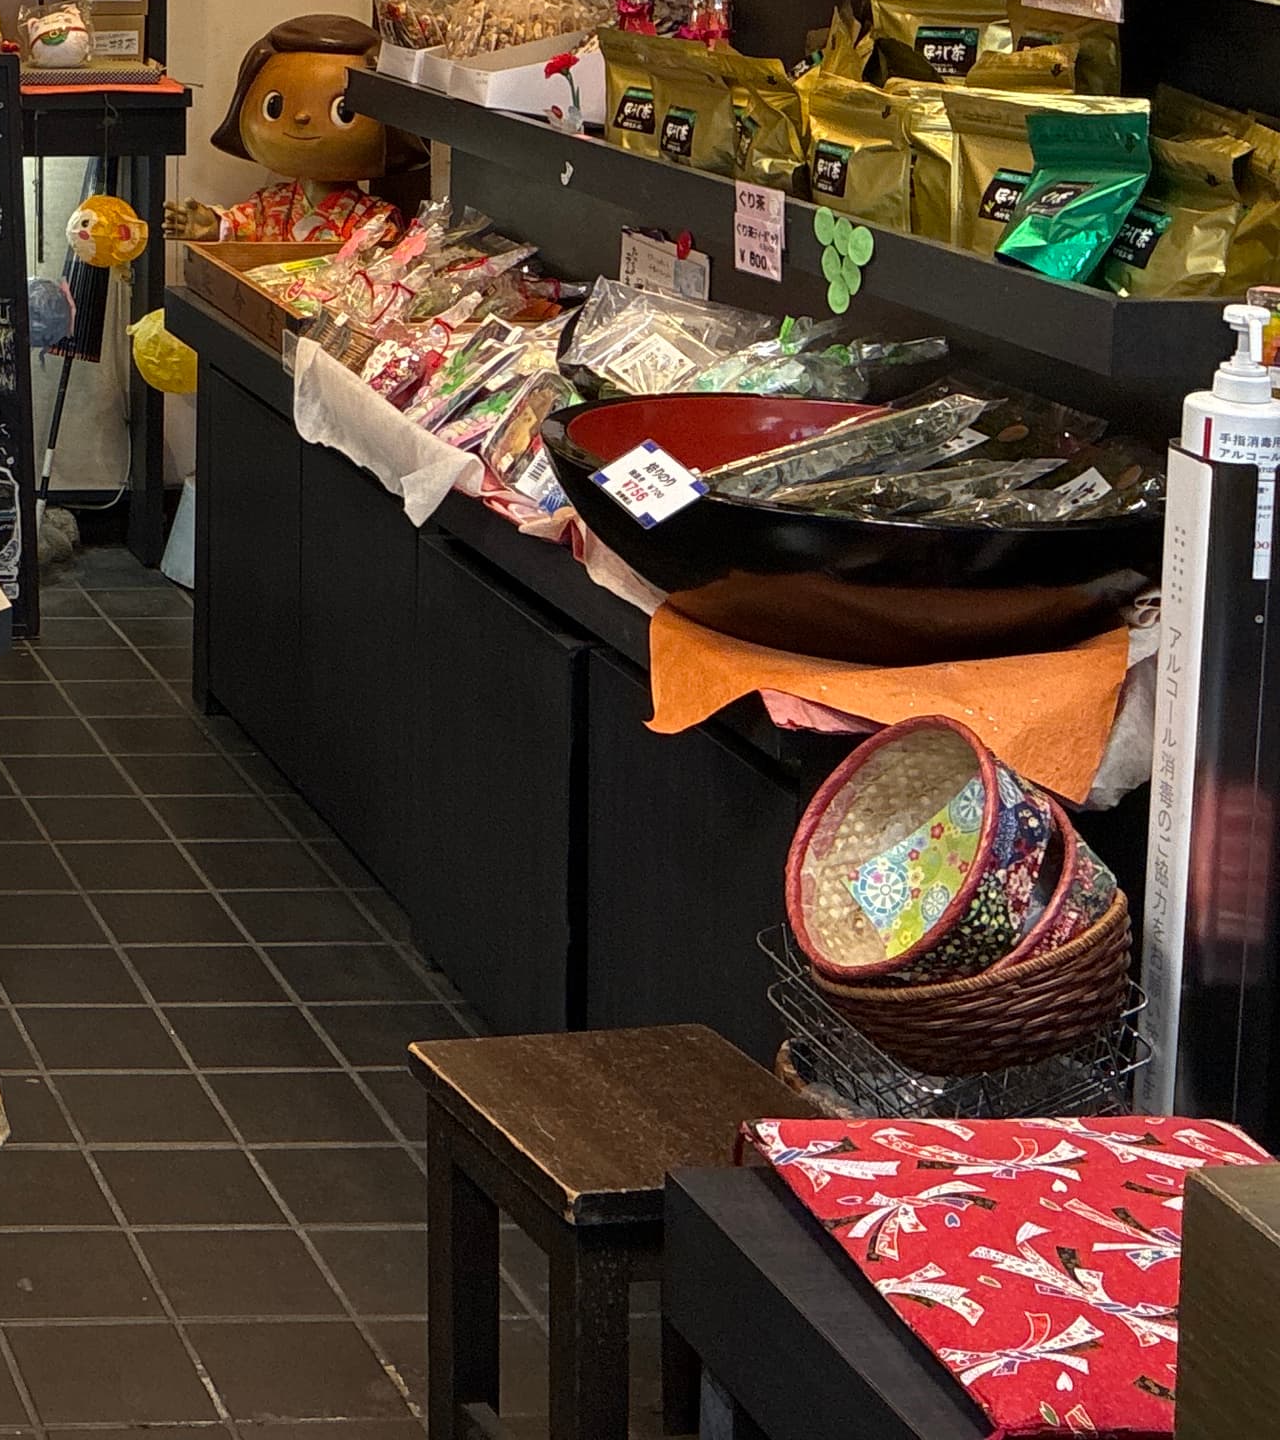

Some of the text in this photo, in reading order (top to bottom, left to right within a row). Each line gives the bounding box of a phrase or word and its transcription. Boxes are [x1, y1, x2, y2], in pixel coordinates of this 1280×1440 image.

[923, 43, 967, 64] ほうじ茶
[738, 189, 766, 212] ぐり茶
